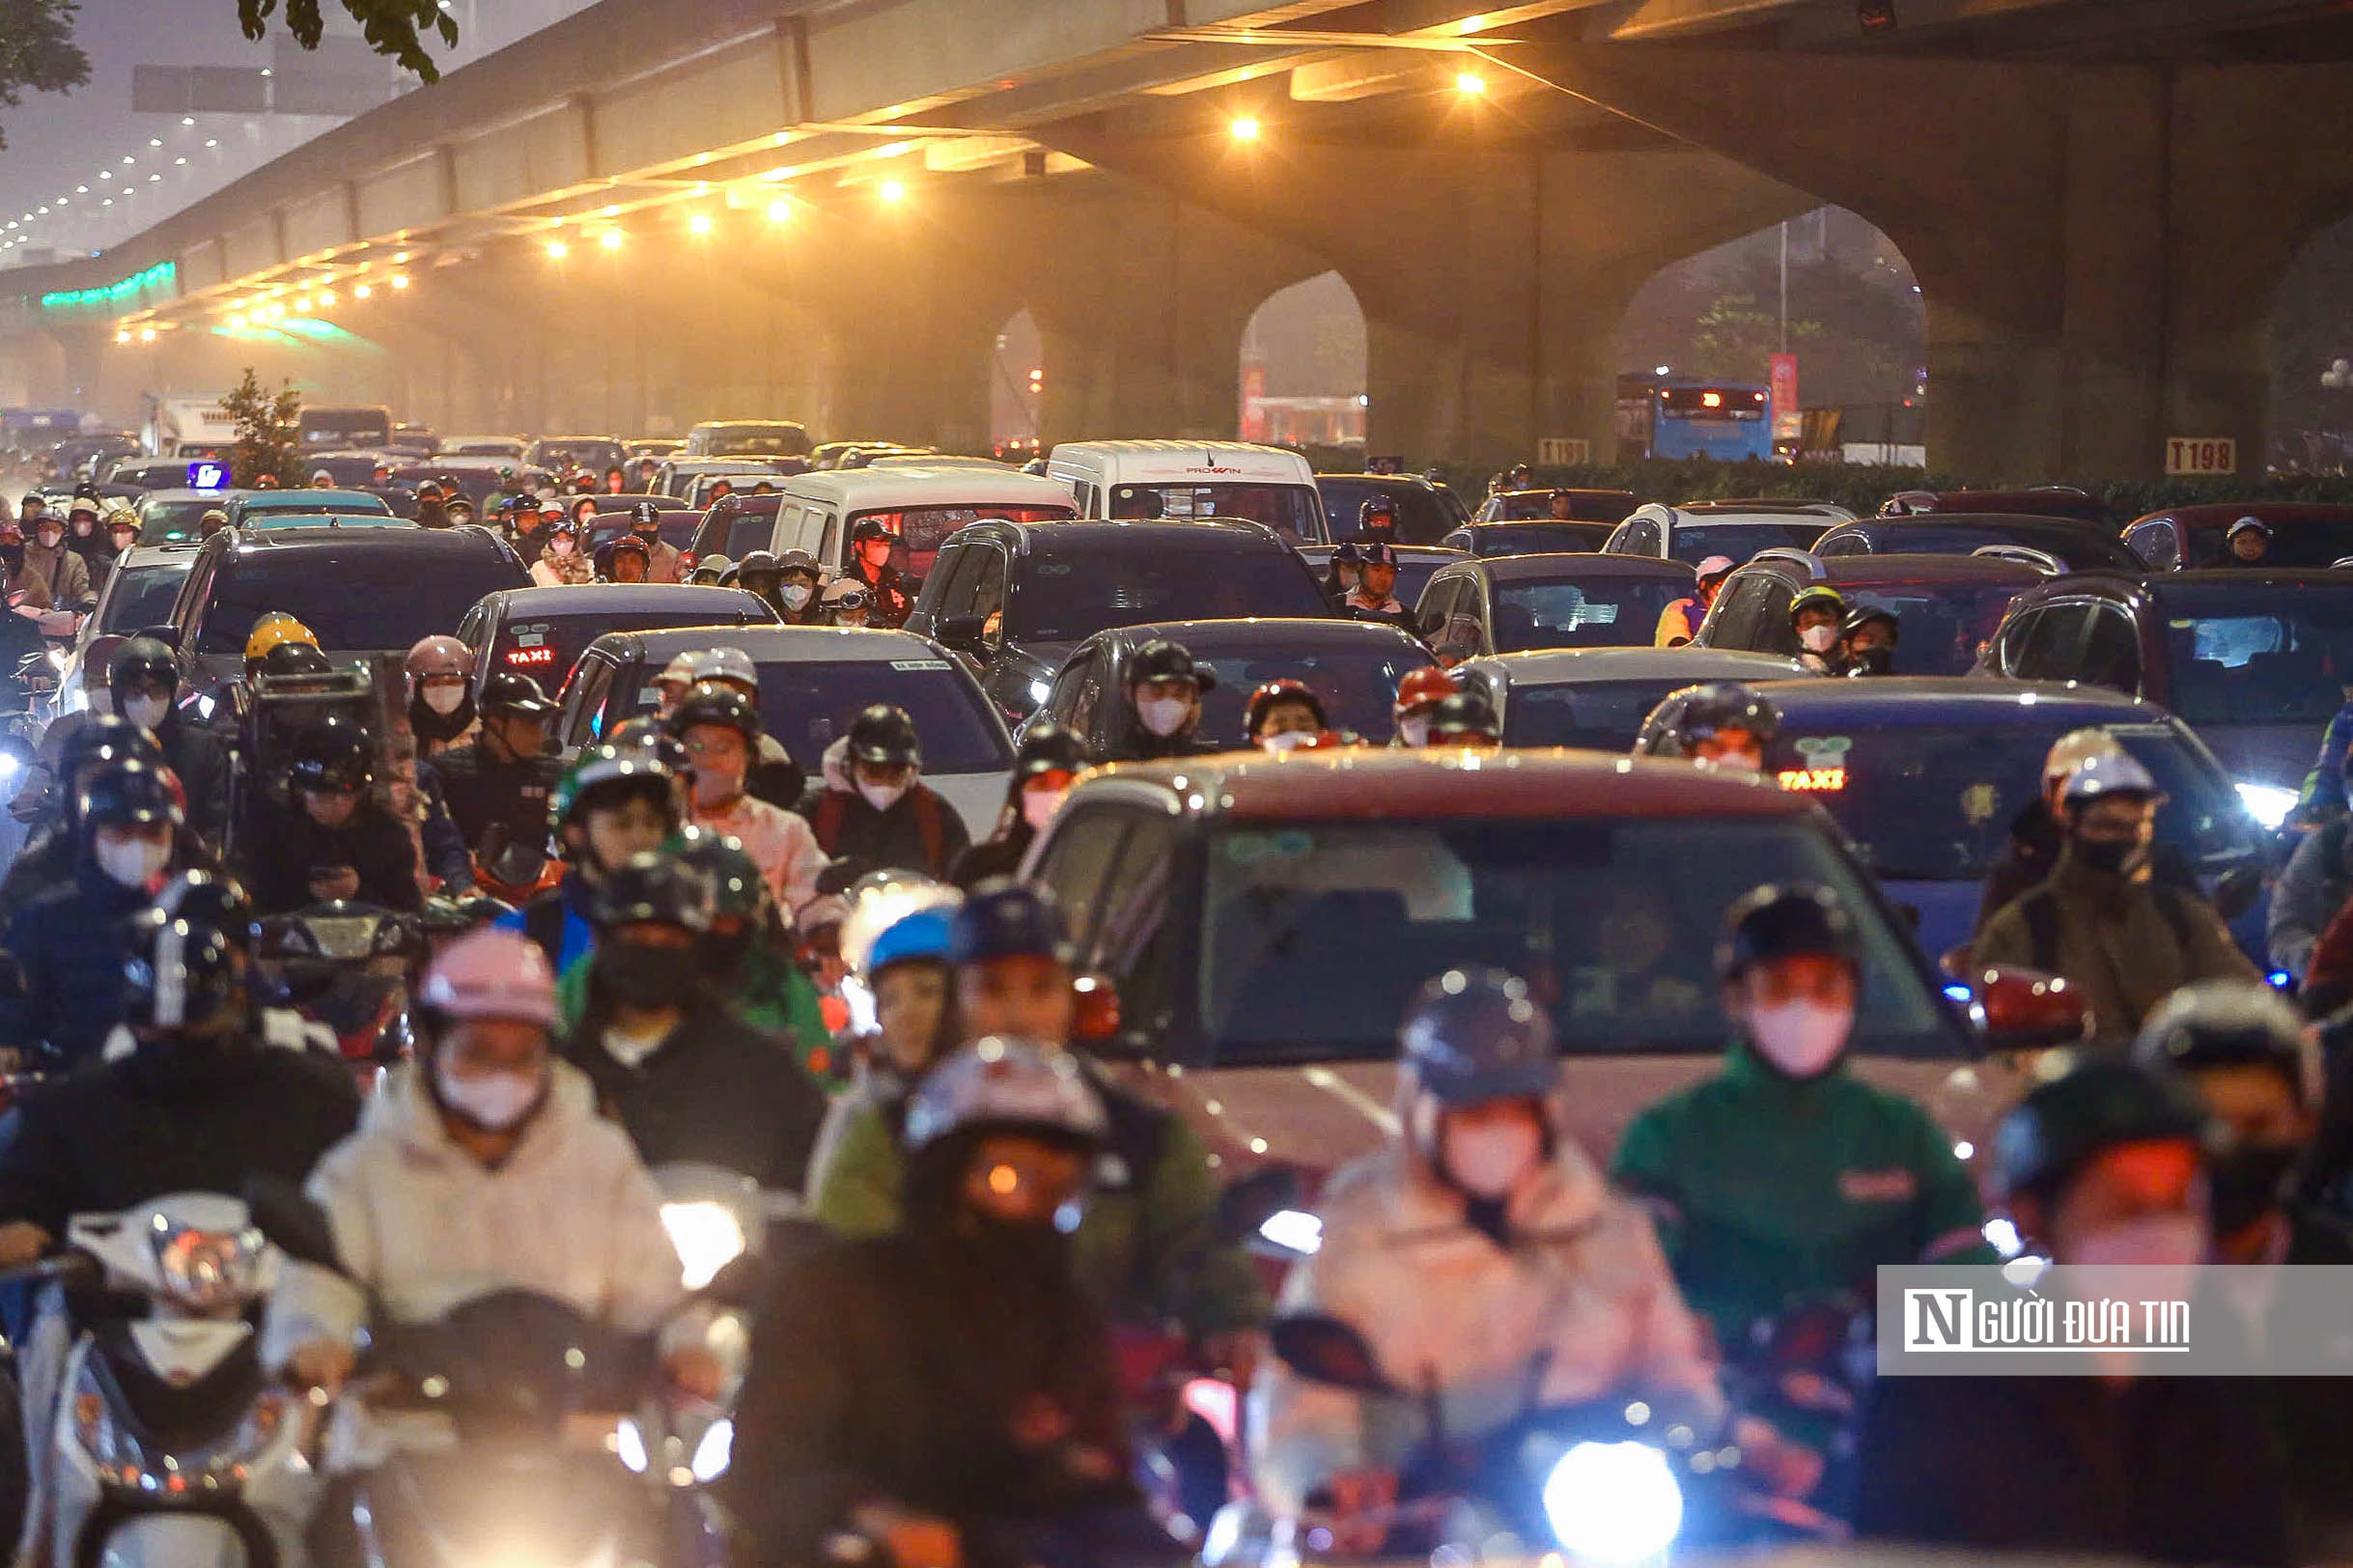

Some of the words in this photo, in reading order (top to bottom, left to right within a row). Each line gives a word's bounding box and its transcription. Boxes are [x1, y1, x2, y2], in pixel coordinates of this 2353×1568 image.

[2171, 441, 2230, 470] T198
[508, 649, 552, 664] TAXI
[1779, 769, 1845, 791] TAXI
